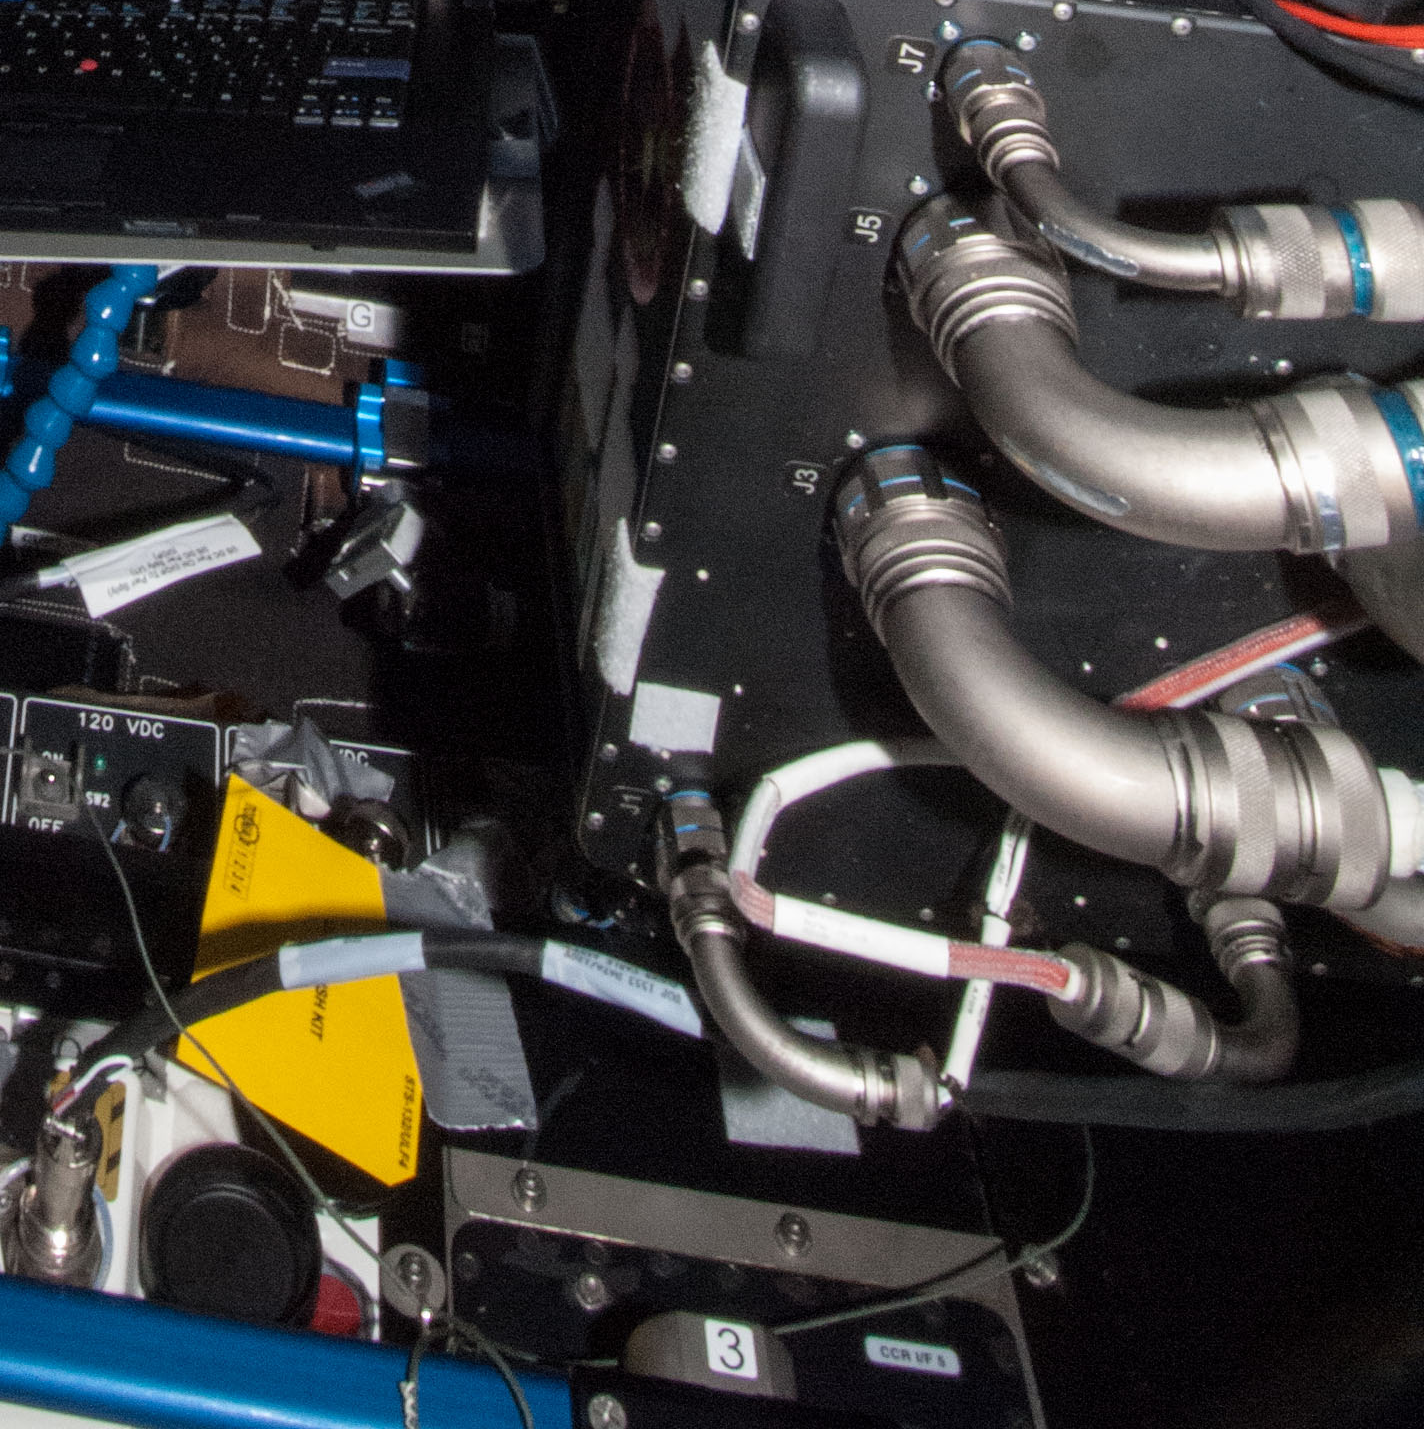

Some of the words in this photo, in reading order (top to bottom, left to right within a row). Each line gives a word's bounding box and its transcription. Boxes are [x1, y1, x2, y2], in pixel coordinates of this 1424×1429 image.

[898, 42, 925, 73] J7
[855, 215, 881, 242] J5
[350, 302, 373, 328] G
[793, 468, 818, 494] J3
[77, 711, 115, 732] 120
[124, 717, 166, 740] VDC
[84, 790, 111, 809] SW2
[619, 793, 642, 815] J1
[27, 815, 65, 833] OFF
[309, 1011, 325, 1041] KIT
[717, 1327, 744, 1370] 3
[878, 1345, 912, 1363] CCR
[914, 1351, 933, 1366] I/F
